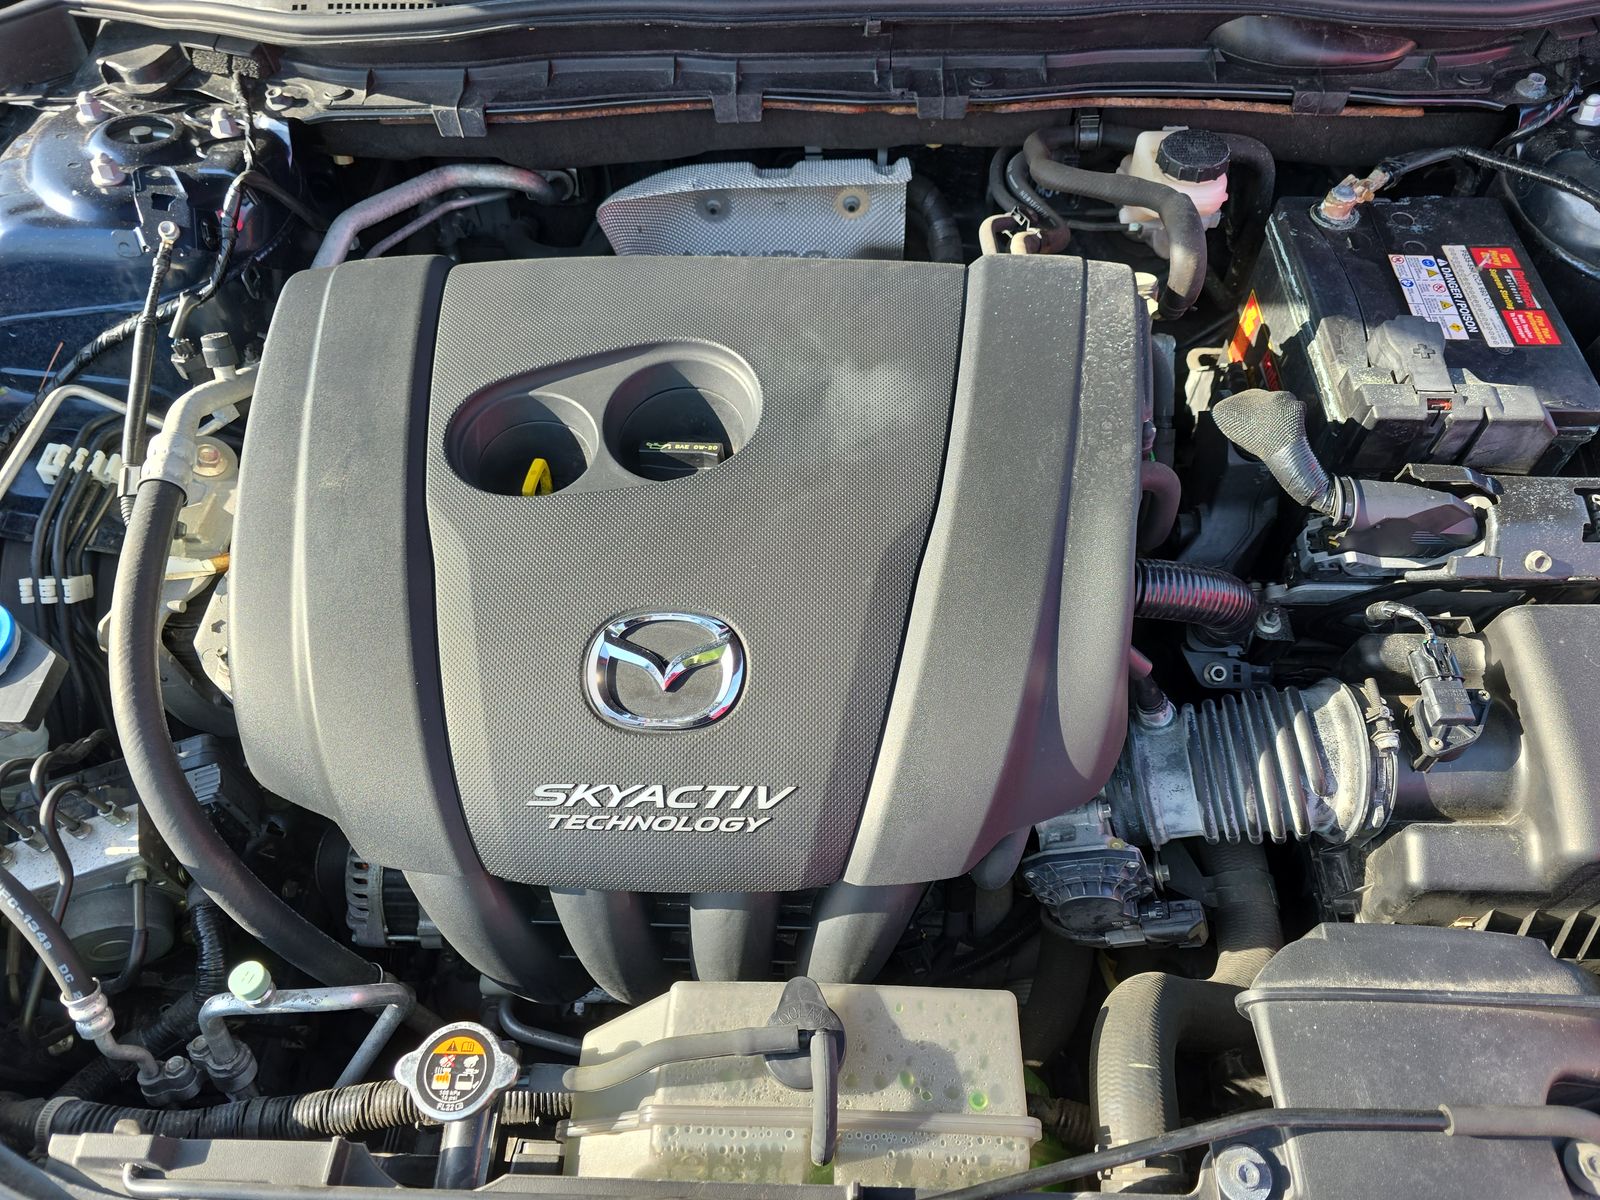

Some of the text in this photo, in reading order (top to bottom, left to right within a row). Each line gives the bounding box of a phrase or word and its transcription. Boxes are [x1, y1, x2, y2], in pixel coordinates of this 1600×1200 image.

[1441, 267, 1464, 300] DANGER
[1489, 269, 1504, 289] Supreme
[1500, 289, 1515, 310] Starting
[1504, 275, 1523, 303] Batteries
[1522, 324, 1533, 339] Tougher
[1525, 311, 1547, 344] Performance
[1534, 315, 1552, 340] Five Year
[525, 783, 798, 810] SKYACTIV
[548, 814, 772, 833] TECHNOLOGY
[0, 884, 52, 950] FC-134a
[58, 963, 74, 983] DC
[436, 1102, 455, 1111] FL22
